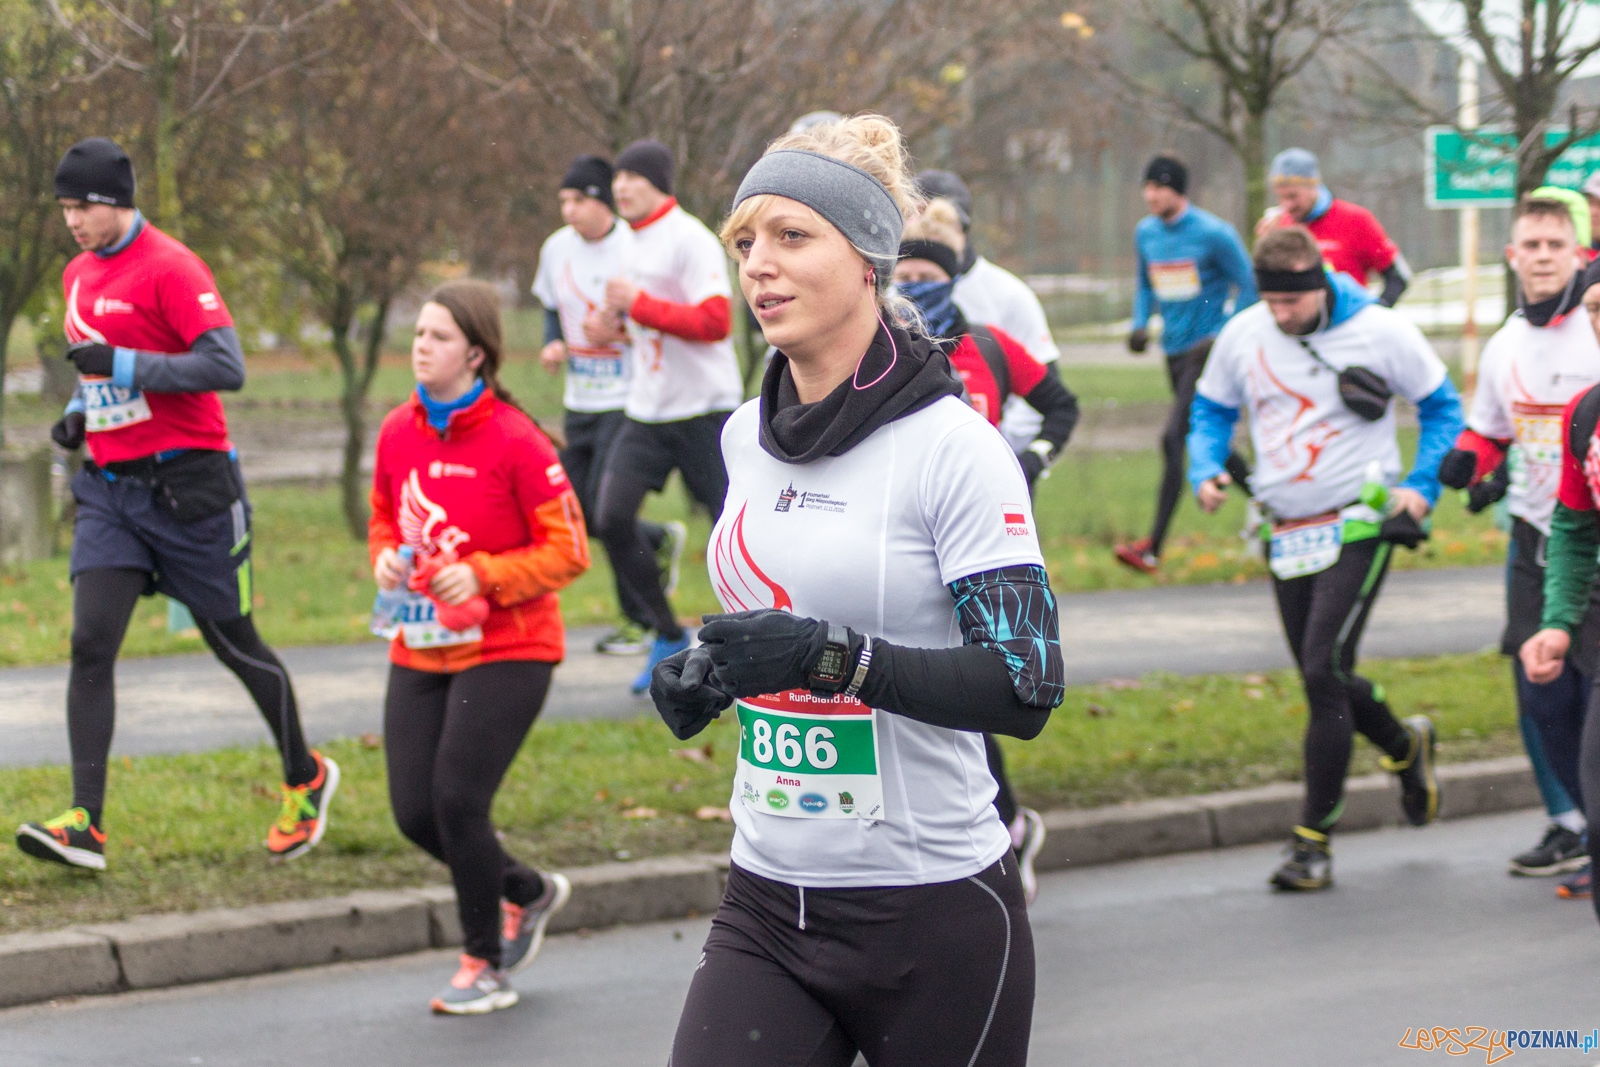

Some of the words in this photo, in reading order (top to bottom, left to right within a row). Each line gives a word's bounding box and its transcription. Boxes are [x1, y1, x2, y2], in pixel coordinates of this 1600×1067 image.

[798, 491, 807, 508] 1
[1006, 527, 1029, 536] POLSKA
[753, 718, 839, 770] 866
[776, 775, 801, 787] Anna
